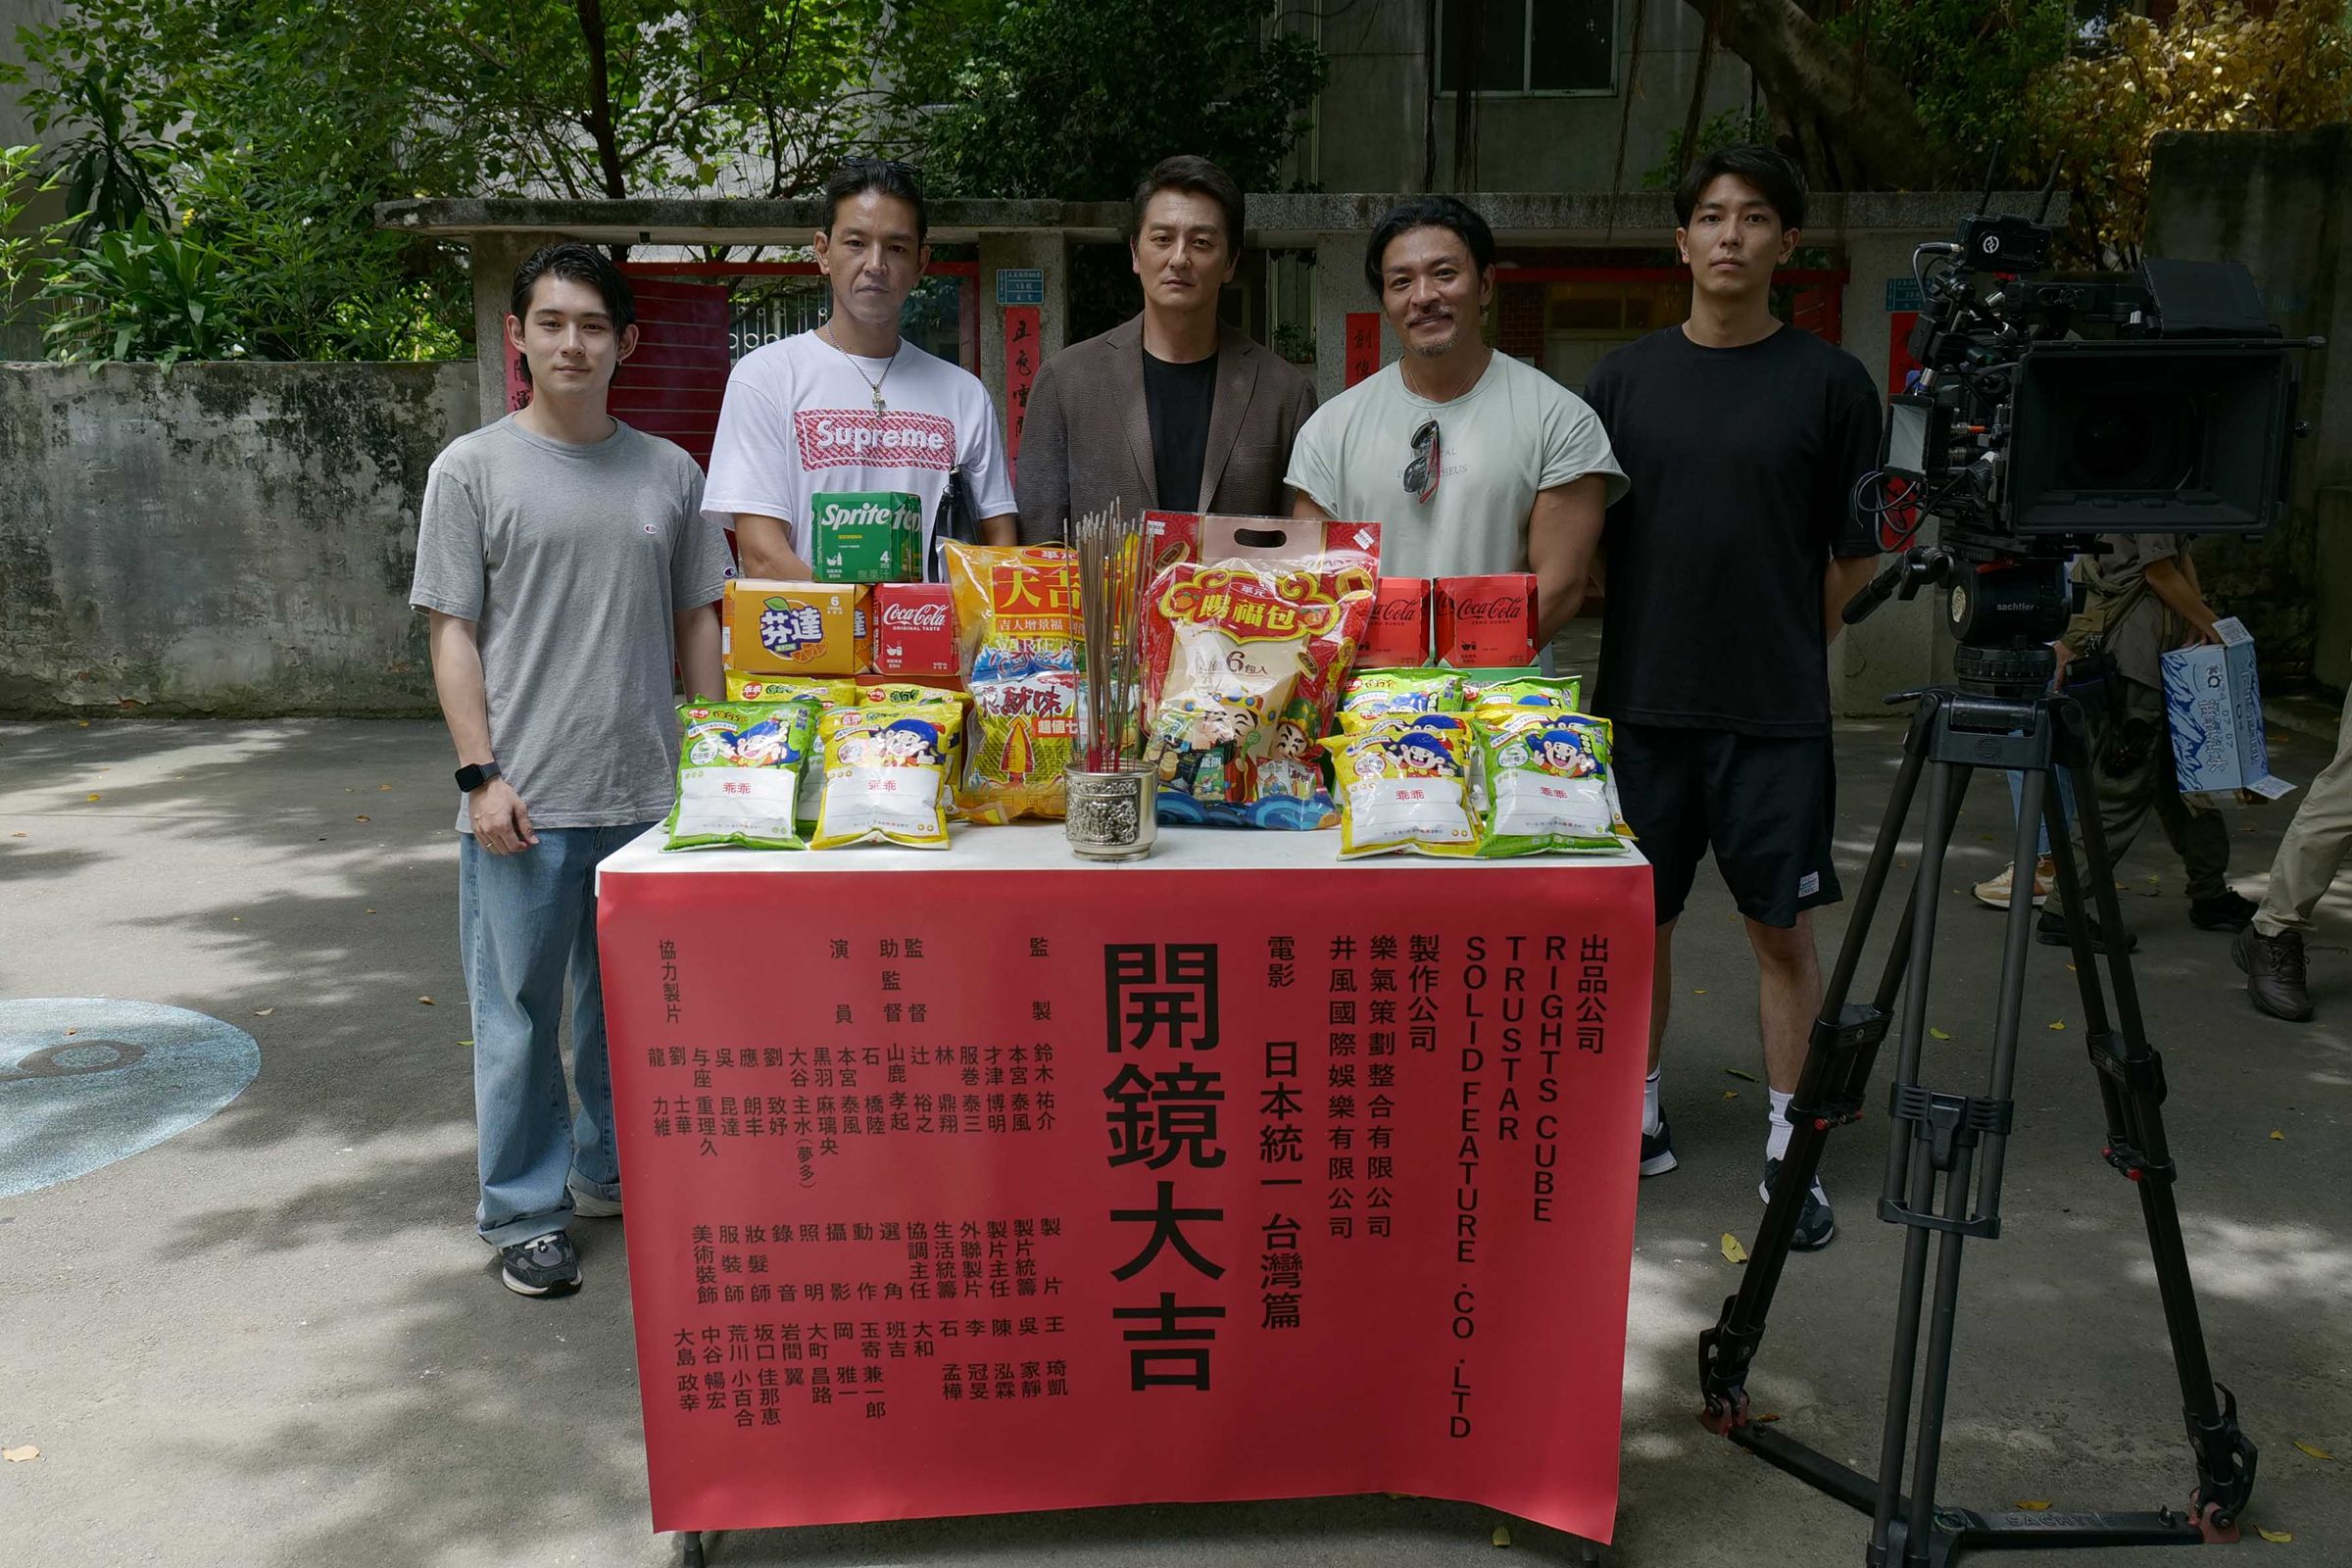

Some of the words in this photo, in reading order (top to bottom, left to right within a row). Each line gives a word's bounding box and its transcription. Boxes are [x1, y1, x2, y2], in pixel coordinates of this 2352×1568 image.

[817, 419, 945, 454] Supreme
[821, 503, 891, 530] Sprite
[880, 551, 890, 563] 4
[761, 608, 822, 646] 芬達
[831, 596, 840, 606] 6
[883, 604, 950, 625] Coca-Cola
[999, 618, 1063, 631] 吉人增景福
[1199, 593, 1296, 630] 賜福包
[1457, 597, 1525, 620] Coca-Cola
[1996, 602, 2035, 611] sachtler
[723, 782, 751, 794] 乖乖
[868, 780, 897, 792] 乖乖
[1396, 789, 1425, 801] 乖乖
[1541, 786, 1567, 799] 乖乖
[661, 941, 680, 1022] 協力製片
[831, 940, 853, 1023] 演員
[880, 940, 902, 1022] 助監督
[906, 939, 926, 1022] 監督
[1030, 937, 1051, 1020] 監製
[1408, 935, 1440, 1052] 製作公司
[1577, 934, 1608, 1054] 出品公司
[1499, 936, 1526, 1140] TRUSTAR
[1539, 936, 1566, 1102] RIGHTS
[649, 1049, 670, 1136] 龍力維
[693, 1049, 716, 1155] 与座重理久
[716, 1049, 739, 1136] 吳昆達
[764, 1049, 787, 1135] 劉致妤
[839, 1048, 861, 1134] 本宮泰風
[888, 1044, 909, 1130] 山鹿孝起
[911, 1047, 933, 1132] 辻裕之
[936, 1047, 957, 1133] 林鼎翔
[985, 1047, 1005, 1132] 才津博明
[1009, 1046, 1031, 1131] 本宮泰風
[1367, 935, 1396, 1238] 樂氣策劃整合有限公司
[1102, 943, 1226, 1392] 開鏡大吉
[1535, 1115, 1557, 1222] CUBE
[694, 1225, 717, 1303] 美術裝飾
[720, 1226, 744, 1301] 服裝師
[801, 1225, 823, 1300] 照明
[826, 1223, 850, 1300] 攝影
[854, 1223, 876, 1299] 動作
[881, 1223, 902, 1299] 選角
[907, 1222, 929, 1298] 協調主任
[934, 1222, 956, 1298] 生活統籌
[961, 1222, 981, 1297] 外聯製片
[988, 1221, 1009, 1298] 製片主任
[1014, 1219, 1036, 1296] 製片統籌
[1042, 1218, 1062, 1294] 製片
[674, 1329, 699, 1411] 大島政幸
[729, 1325, 754, 1427] 荒川小百合
[782, 1324, 804, 1385] 岩間翼
[808, 1323, 832, 1403] 大町昌路
[834, 1323, 857, 1395] 岡雅一
[887, 1322, 906, 1357] 班吉
[913, 1321, 933, 1356] 大和
[1046, 1317, 1068, 1396] 王琦凱
